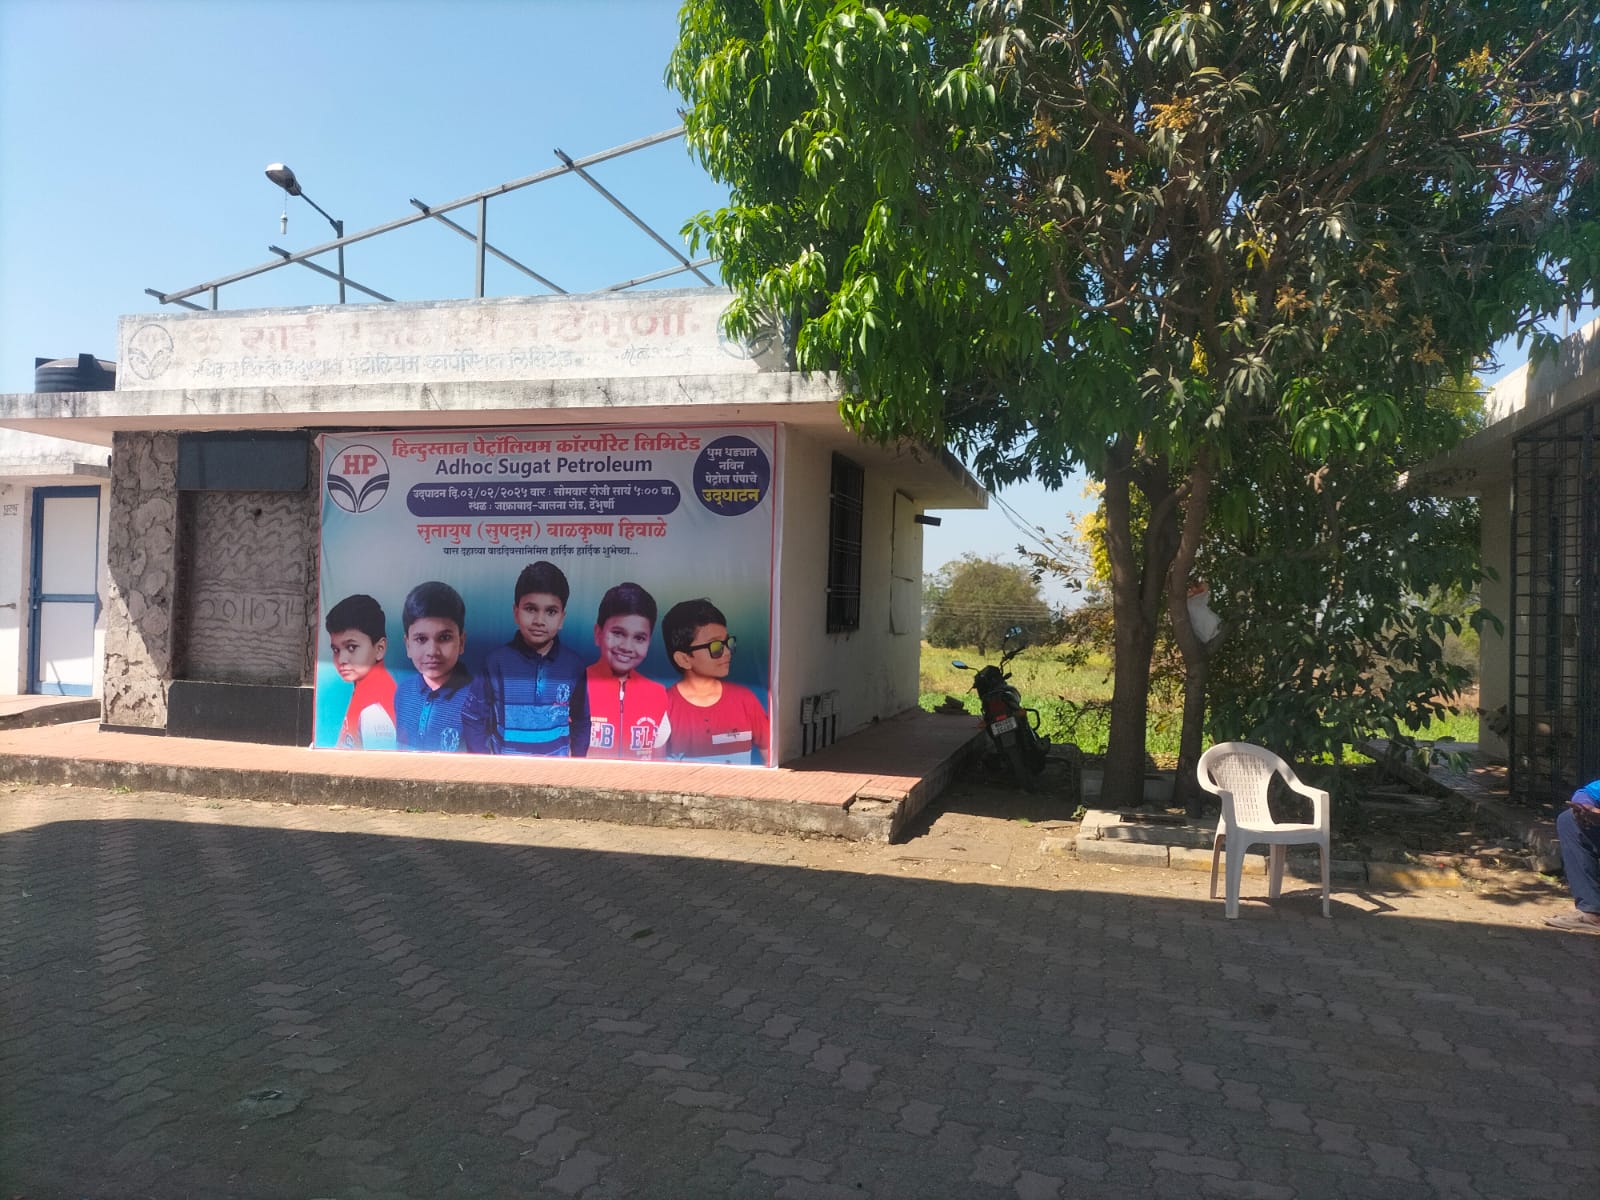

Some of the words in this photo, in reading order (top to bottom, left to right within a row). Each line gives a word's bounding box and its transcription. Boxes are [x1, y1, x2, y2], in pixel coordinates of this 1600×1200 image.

[392, 437, 469, 462] हिन्दुस्तान
[473, 436, 552, 457] पेट्रॉलियम
[634, 431, 701, 452] लिमिटेड
[343, 454, 378, 475] HP
[436, 458, 493, 475] Adhoc
[498, 458, 550, 478] Sugat
[557, 456, 652, 473] Petroleum
[718, 459, 745, 471] नविन
[705, 471, 730, 486] पेट्रोल
[732, 471, 758, 484] पंपाचे
[553, 485, 588, 497] सोमवार
[590, 484, 610, 496] रोजी
[613, 484, 631, 496] सायं
[468, 502, 487, 512] स्थळ
[618, 517, 667, 540] हिवाळे
[550, 544, 574, 556] हार्दिक
[576, 544, 600, 556] हार्दिक
